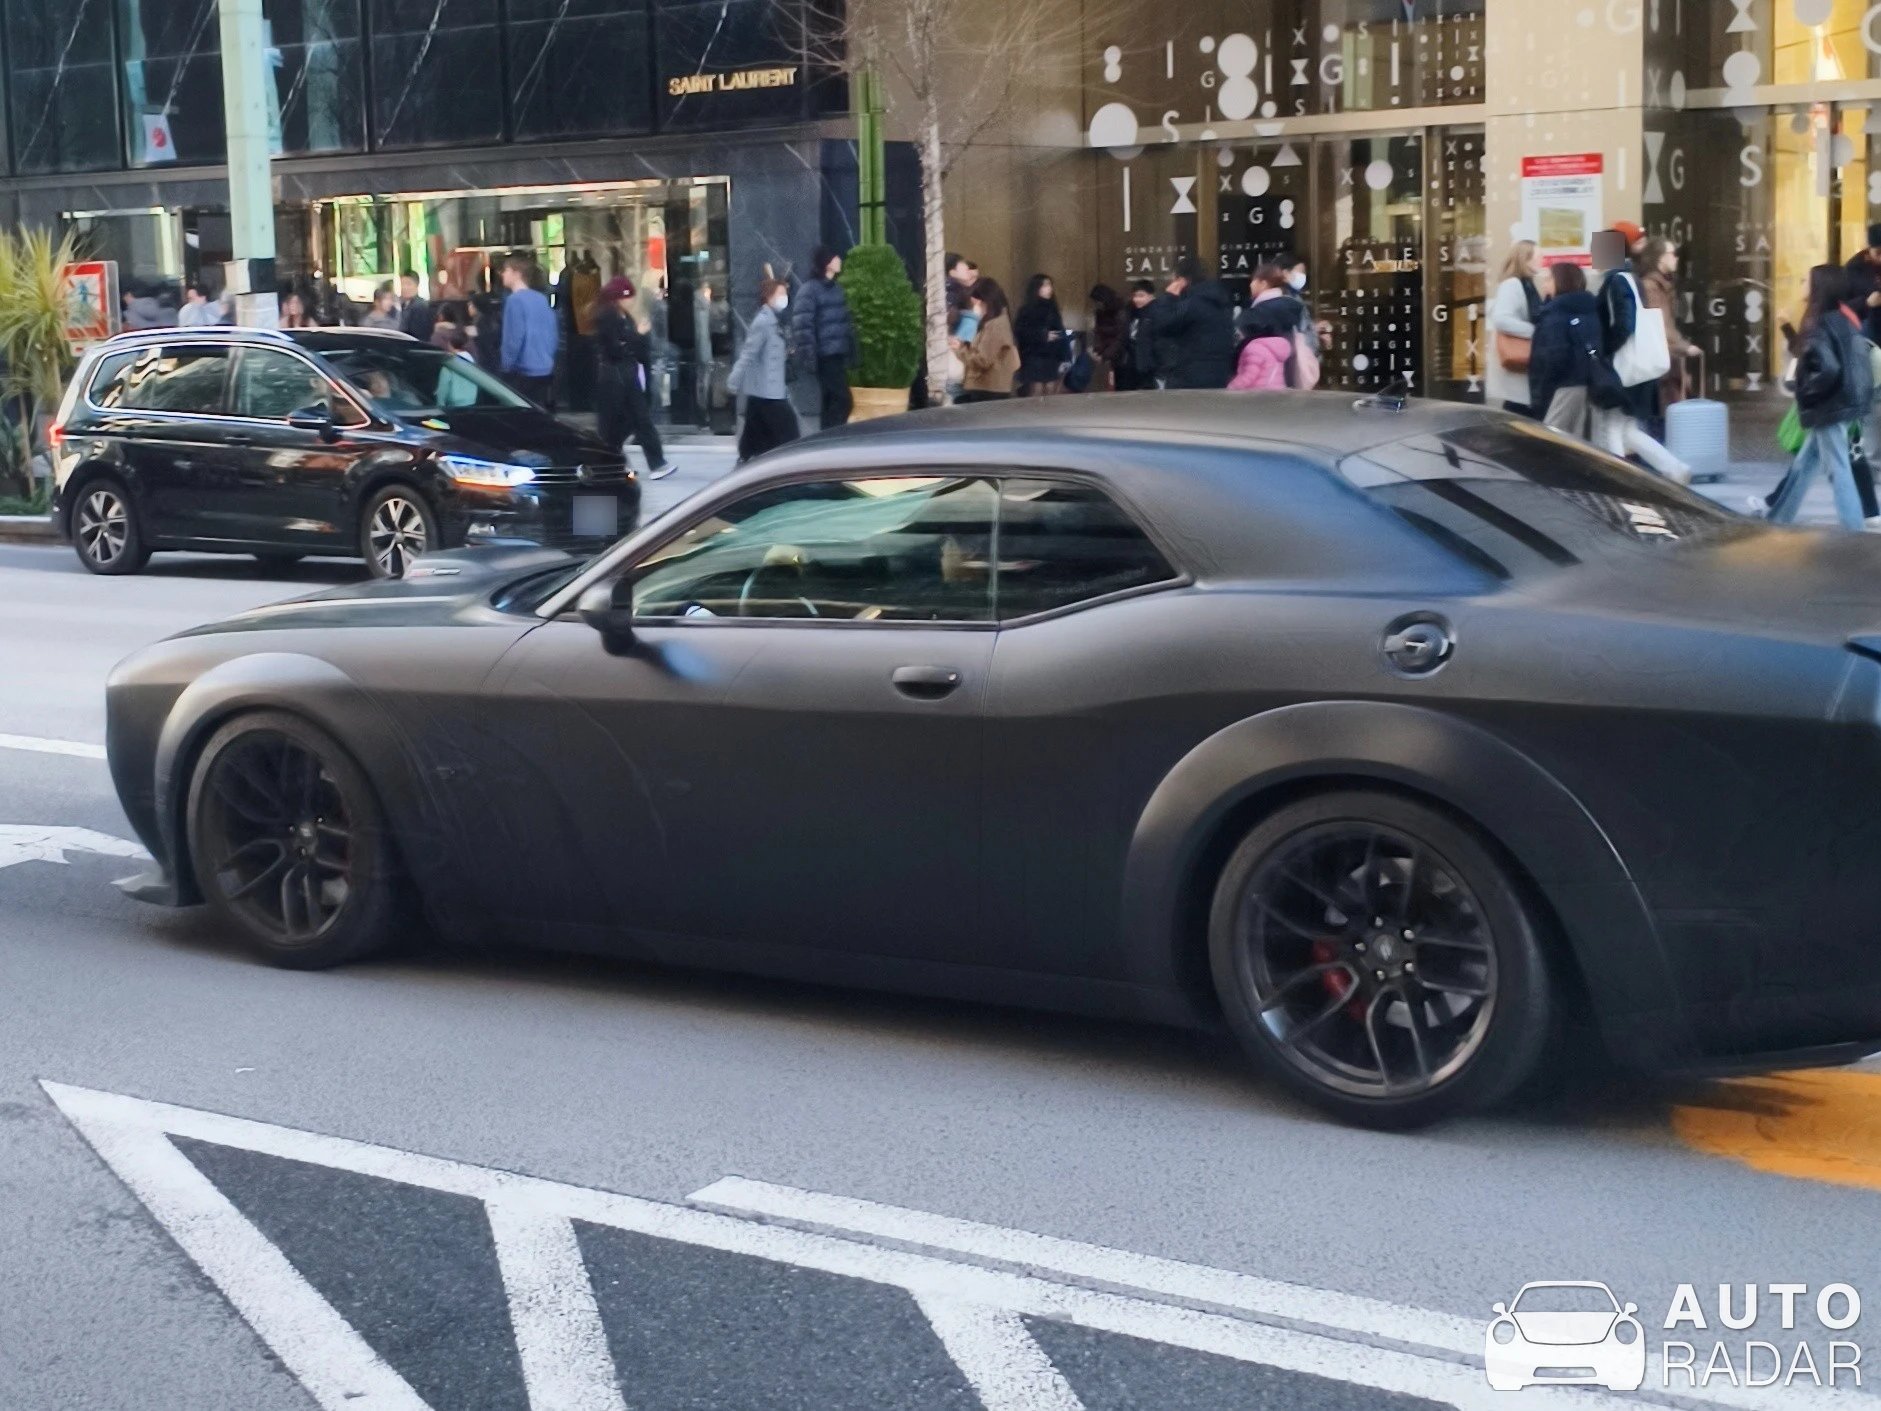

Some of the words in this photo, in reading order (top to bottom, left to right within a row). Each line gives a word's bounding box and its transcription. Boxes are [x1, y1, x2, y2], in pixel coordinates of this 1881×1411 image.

[1319, 54, 1343, 85] G
[669, 74, 716, 95] SAINT
[718, 67, 797, 91] LAURENT
[1201, 71, 1215, 88] G
[1162, 110, 1180, 142] S
[1740, 145, 1762, 187] S
[1219, 174, 1232, 192] X
[1249, 207, 1264, 224] G
[1125, 256, 1186, 272] SAL
[1345, 247, 1413, 265] SALE
[1432, 304, 1448, 322] G
[1708, 298, 1726, 316] G
[1466, 340, 1478, 358] X
[1746, 335, 1761, 353] X
